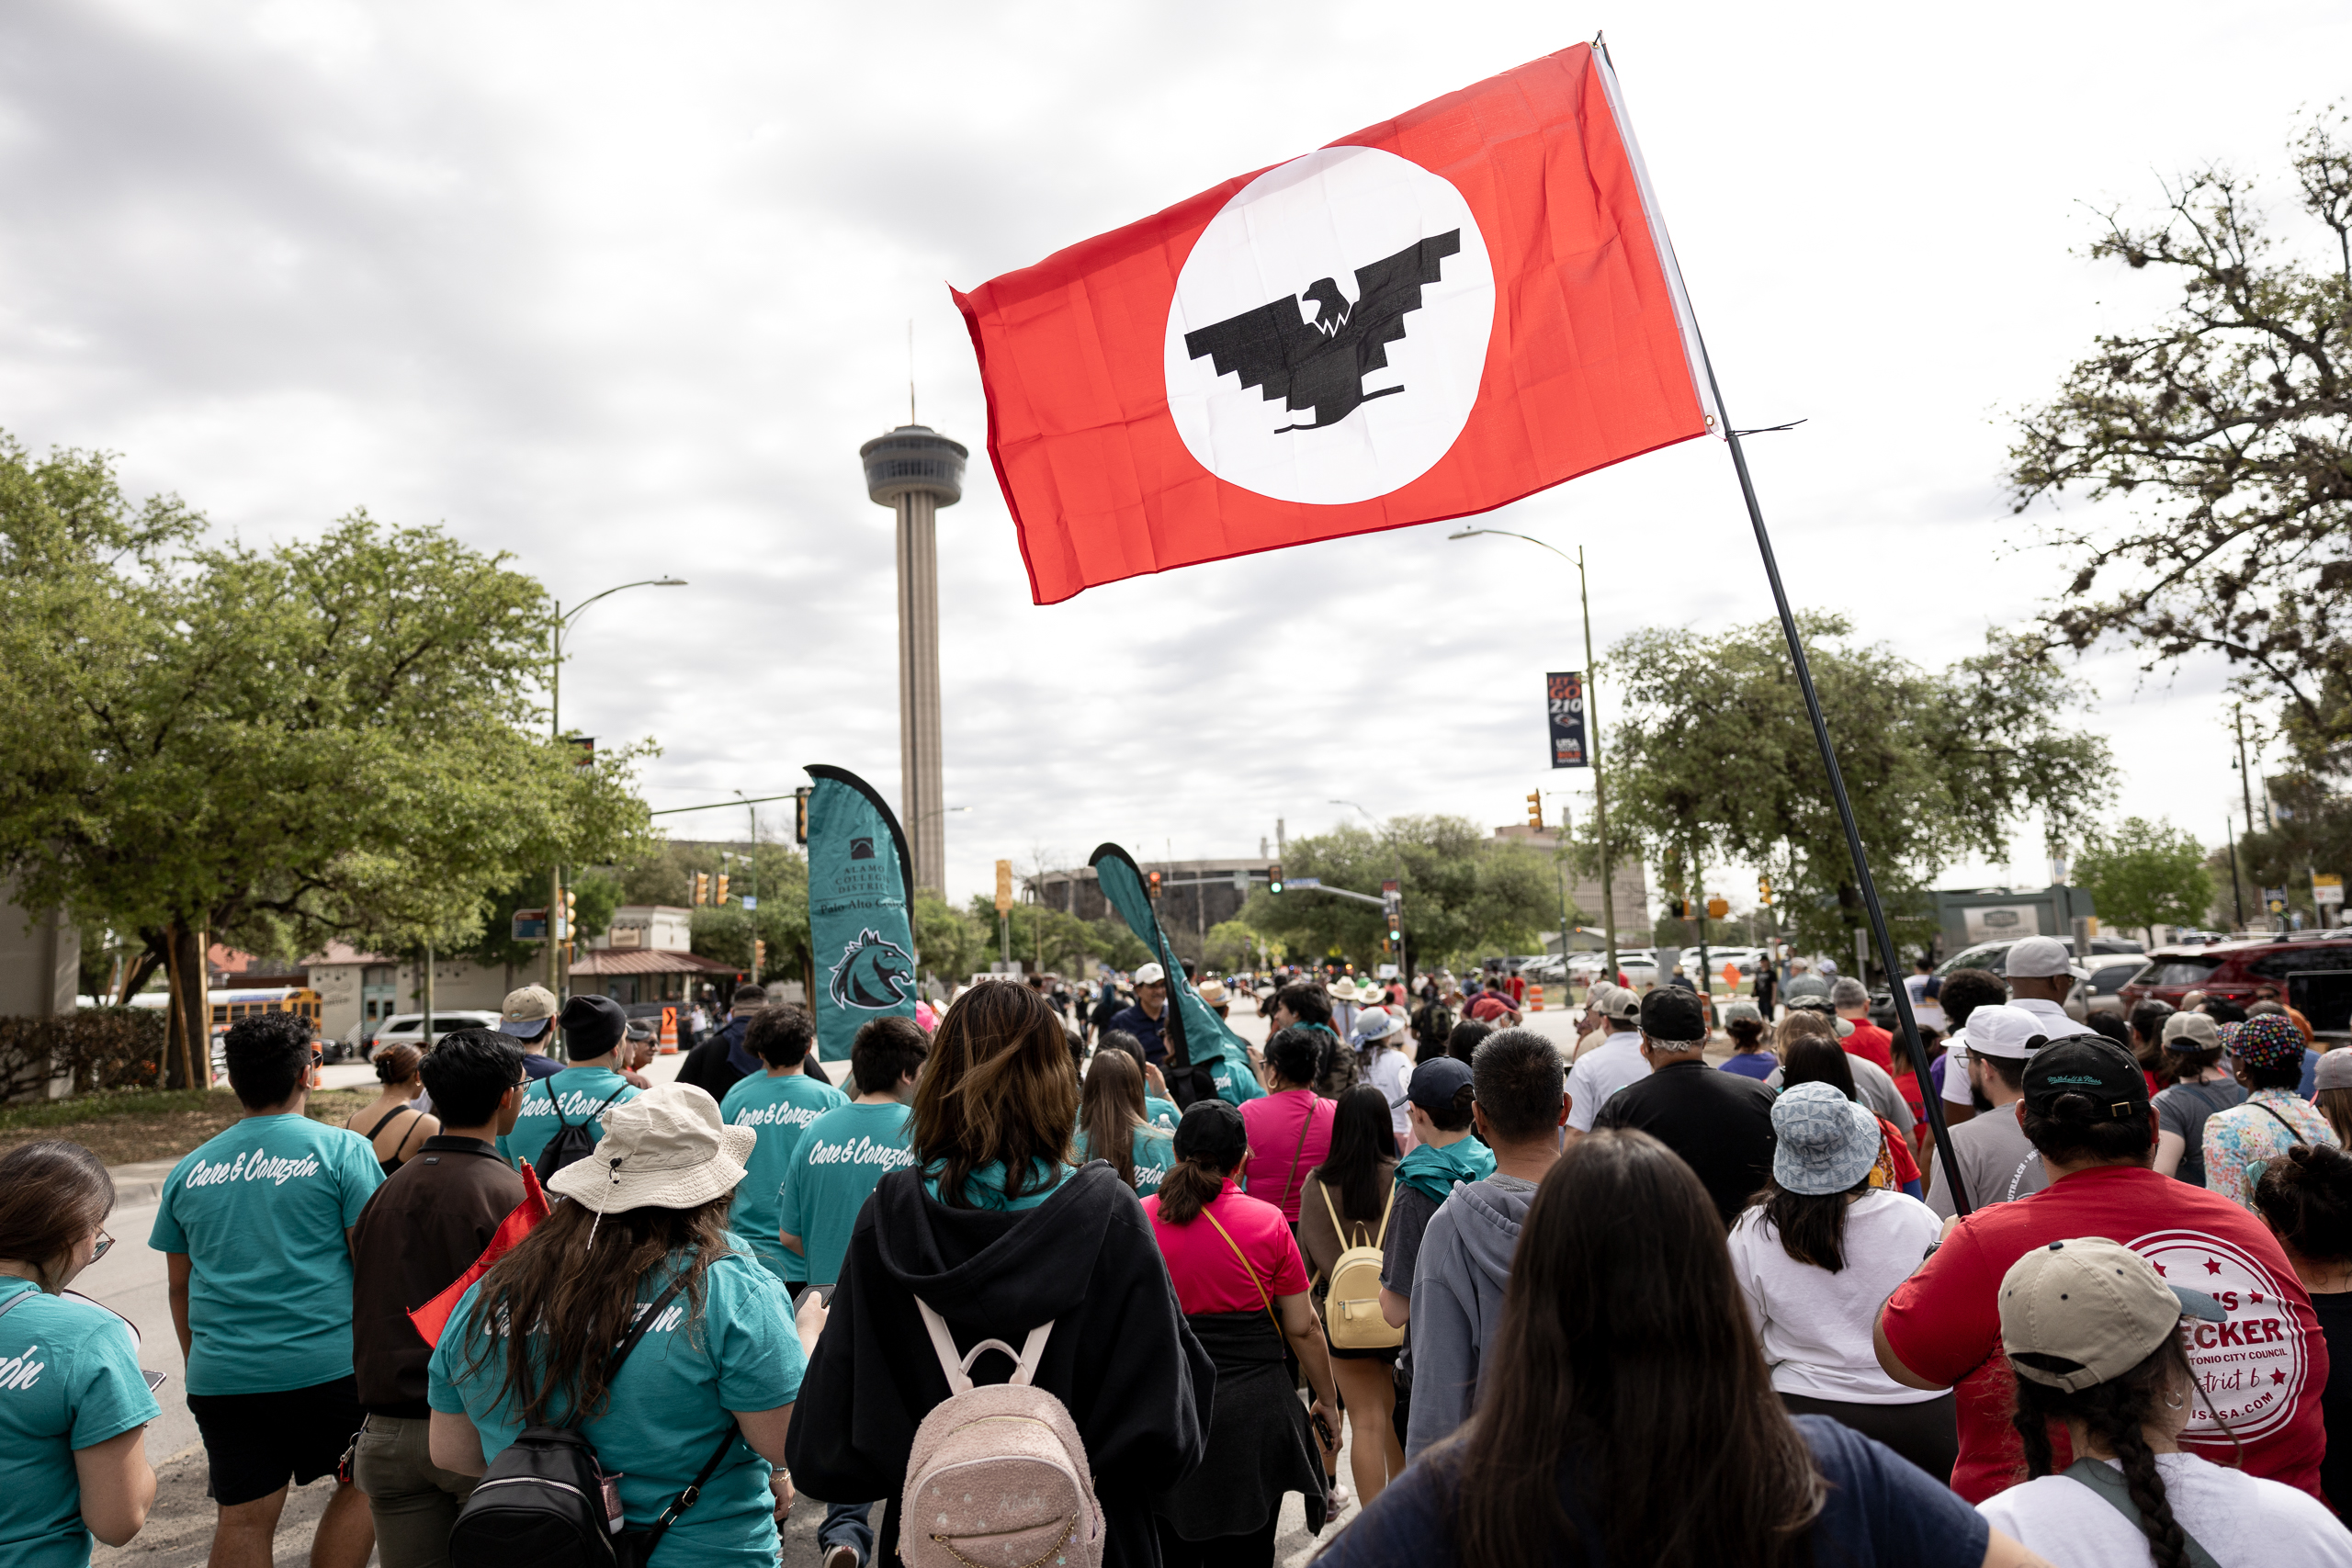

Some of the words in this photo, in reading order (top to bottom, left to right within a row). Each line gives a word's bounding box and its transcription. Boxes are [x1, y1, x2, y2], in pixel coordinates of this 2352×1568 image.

[1549, 685, 1581, 699] GO
[1550, 698, 1582, 713] 210
[844, 864, 885, 874] ALAMO
[839, 883, 889, 894] DISTRICT
[820, 902, 845, 914] Palo
[849, 899, 872, 909] Alto
[2047, 1075, 2077, 1083] Mitchell
[2083, 1075, 2102, 1085] Ness
[518, 1093, 550, 1117] Care
[551, 1092, 568, 1115] &
[735, 1107, 764, 1127] Care
[763, 1103, 776, 1124] &
[775, 1100, 826, 1129] Corazó
[808, 1139, 842, 1165] Care
[841, 1137, 856, 1163] &
[854, 1135, 915, 1172] Corazón
[186, 1159, 231, 1189] Care
[230, 1152, 246, 1181] &
[243, 1147, 320, 1186] Corazón
[2207, 1292, 2239, 1311] IS
[2180, 1318, 2284, 1350] ECKER
[2190, 1355, 2222, 1366] TONIO
[2223, 1353, 2246, 1362] CITY
[2249, 1348, 2288, 1359] COUNCIL
[2192, 1392, 2274, 1420] IS4SA.COM
[997, 1489, 1046, 1517] Kirby
